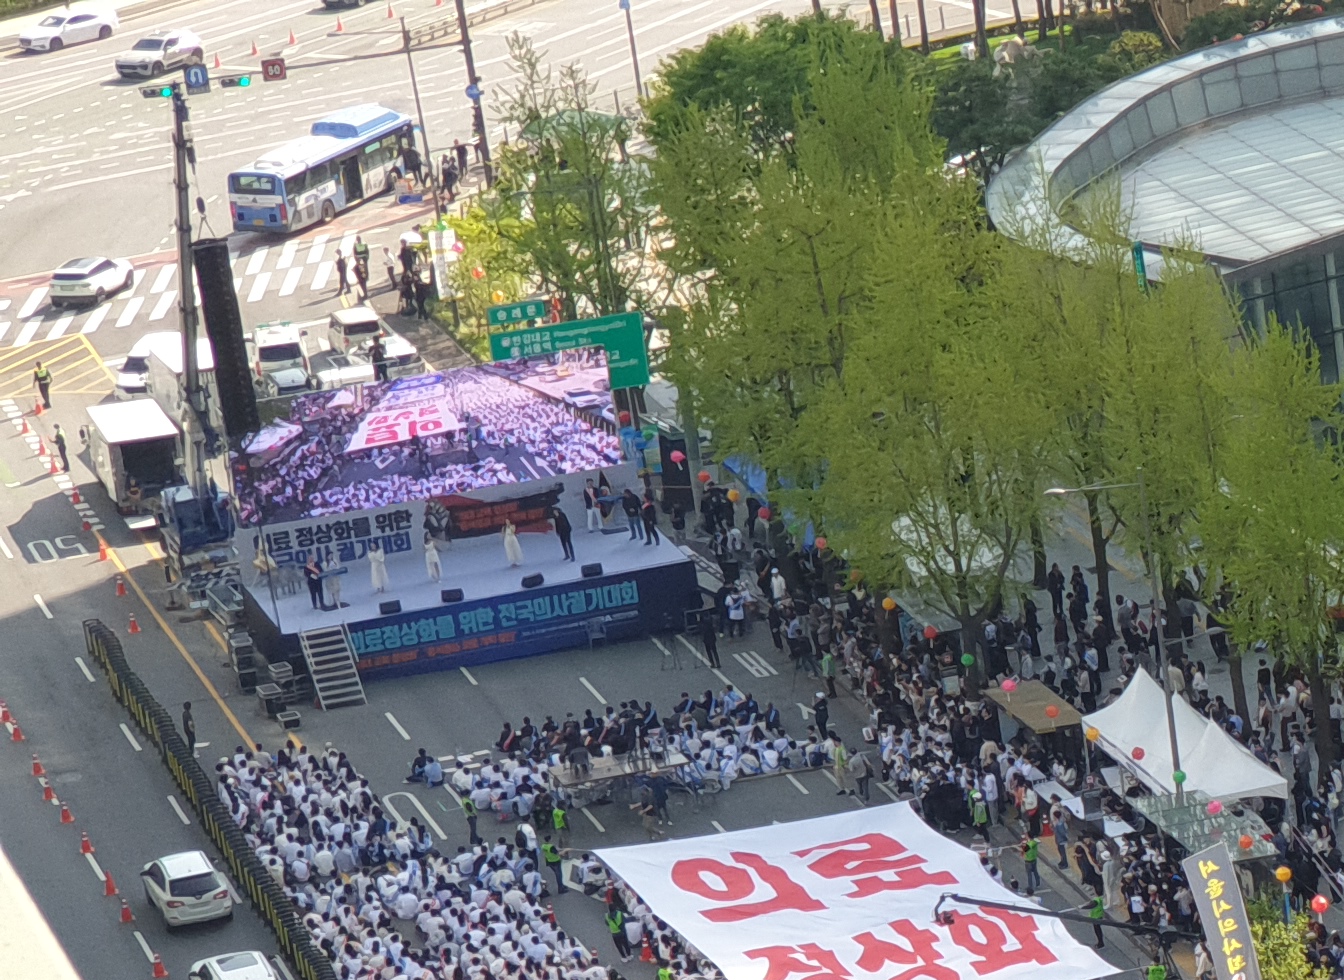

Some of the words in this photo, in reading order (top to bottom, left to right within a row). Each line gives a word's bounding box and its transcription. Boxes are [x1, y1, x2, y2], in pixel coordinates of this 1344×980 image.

[294, 517, 372, 549] 정상화를
[374, 508, 413, 534] 위한
[459, 608, 496, 636] 위한
[668, 832, 959, 923] 의료
